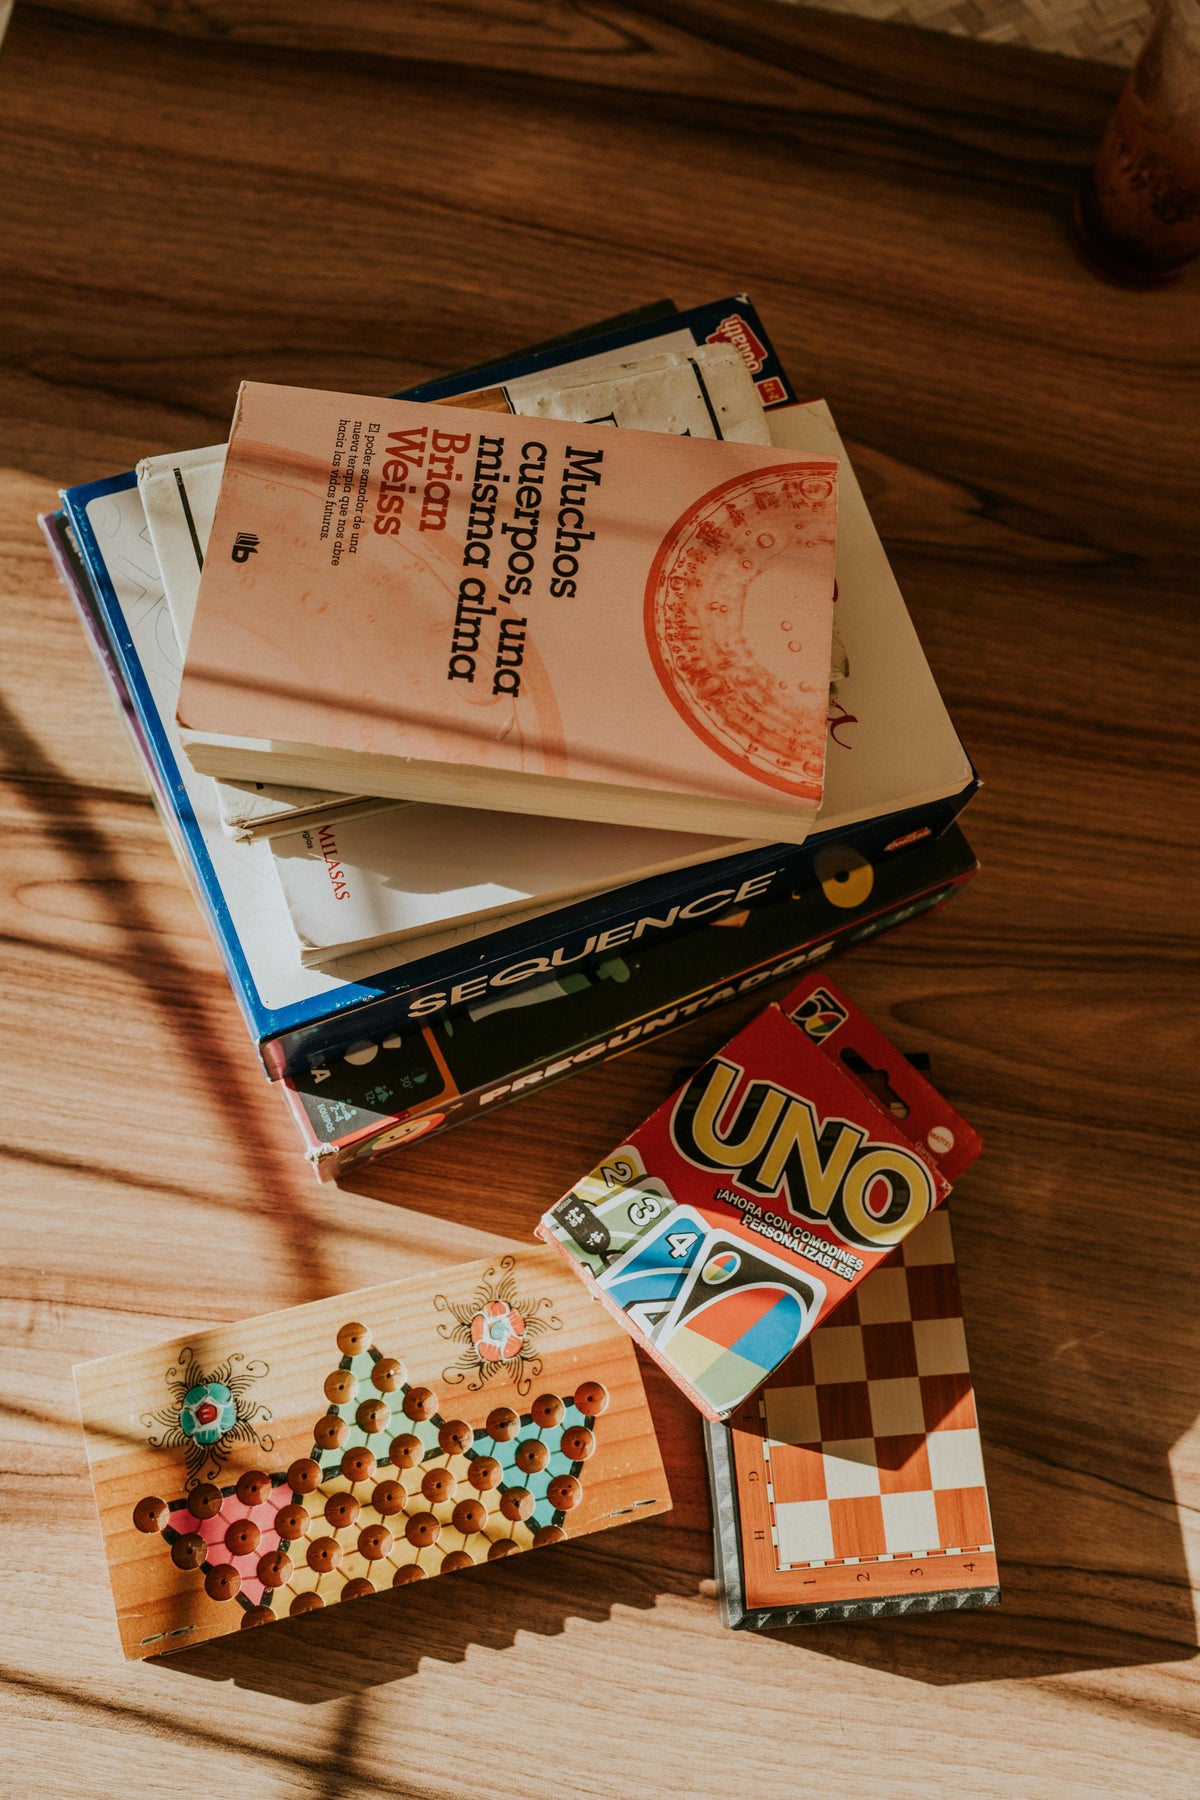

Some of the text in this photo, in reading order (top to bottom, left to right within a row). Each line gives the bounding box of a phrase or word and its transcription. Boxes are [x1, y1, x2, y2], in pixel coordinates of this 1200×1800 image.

[319, 419, 350, 541] hacia las vidas futuras.
[331, 421, 362, 567] nueva terapia que nos abre
[348, 422, 381, 554] El poder sanador de una
[373, 426, 429, 536] Weiss
[419, 429, 472, 532] Brian
[550, 445, 604, 598] Muchos
[448, 434, 511, 683] misma alma
[492, 441, 548, 698] cuerpos, una
[407, 871, 777, 1019] SEQUENCE
[479, 940, 837, 1107] PREGUNTADOS
[317, 1103, 335, 1133] EQUIPOS
[330, 1104, 344, 1122] 2-4
[673, 1057, 935, 1250] UNO
[601, 1162, 632, 1188] 2
[628, 1197, 662, 1226] 3
[666, 1232, 699, 1259] 4
[716, 1189, 864, 1271] ¡AHORA CON COMODINES
[742, 1215, 857, 1281] PERSONALIZABLES!
[748, 1471, 759, 1482] G
[754, 1530, 765, 1541] H
[857, 1571, 870, 1582] 2
[909, 1567, 924, 1577] 3
[963, 1561, 976, 1572] 4
